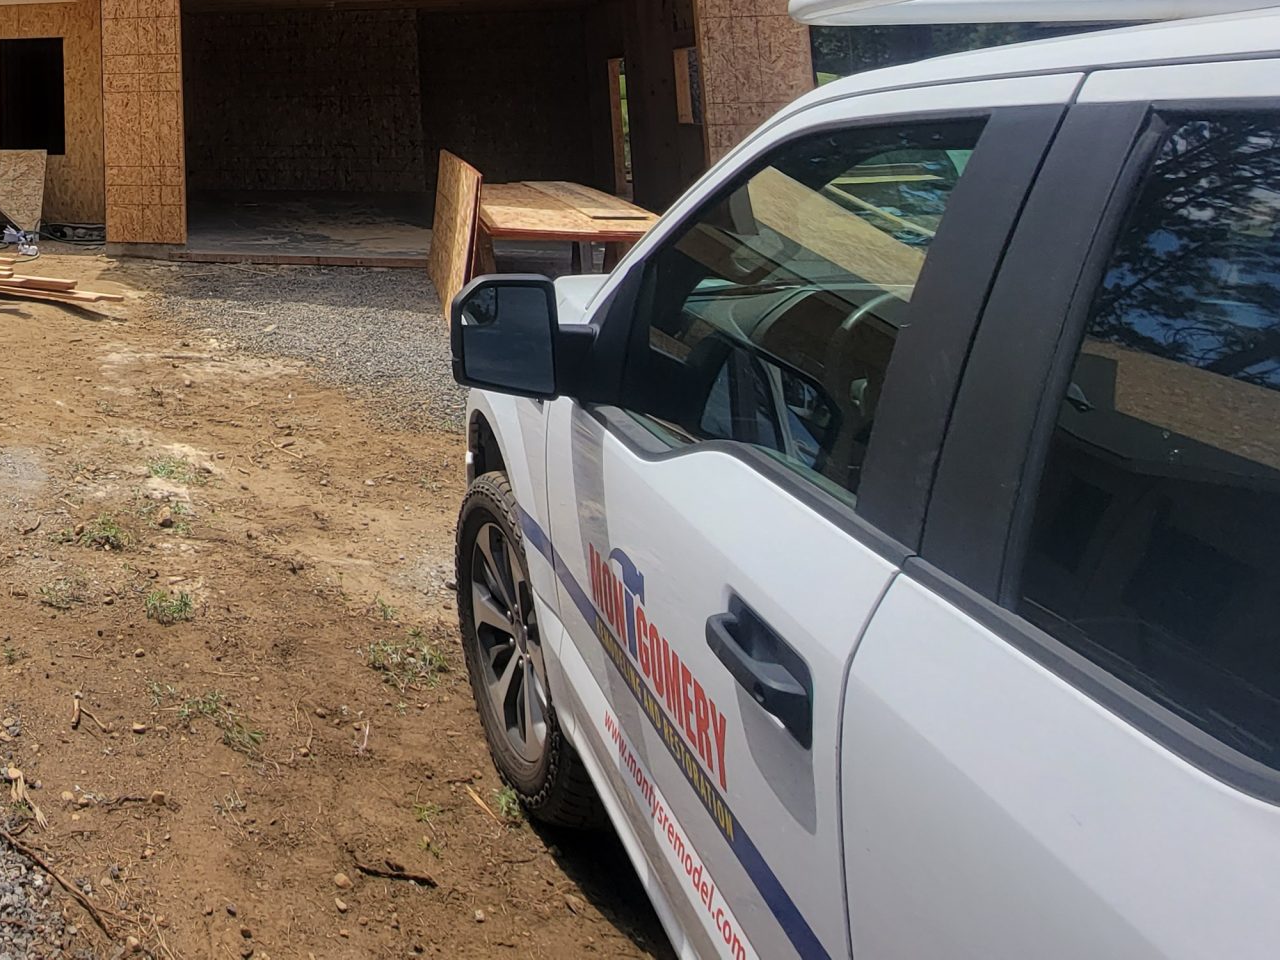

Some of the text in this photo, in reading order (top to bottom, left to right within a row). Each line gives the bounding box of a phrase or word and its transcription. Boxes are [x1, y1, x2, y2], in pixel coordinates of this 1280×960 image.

[588, 542, 728, 793] MONTGOMERY
[595, 615, 735, 842] REMODELING AND RESTORATION
[604, 711, 746, 960] www.montysremodel.com
